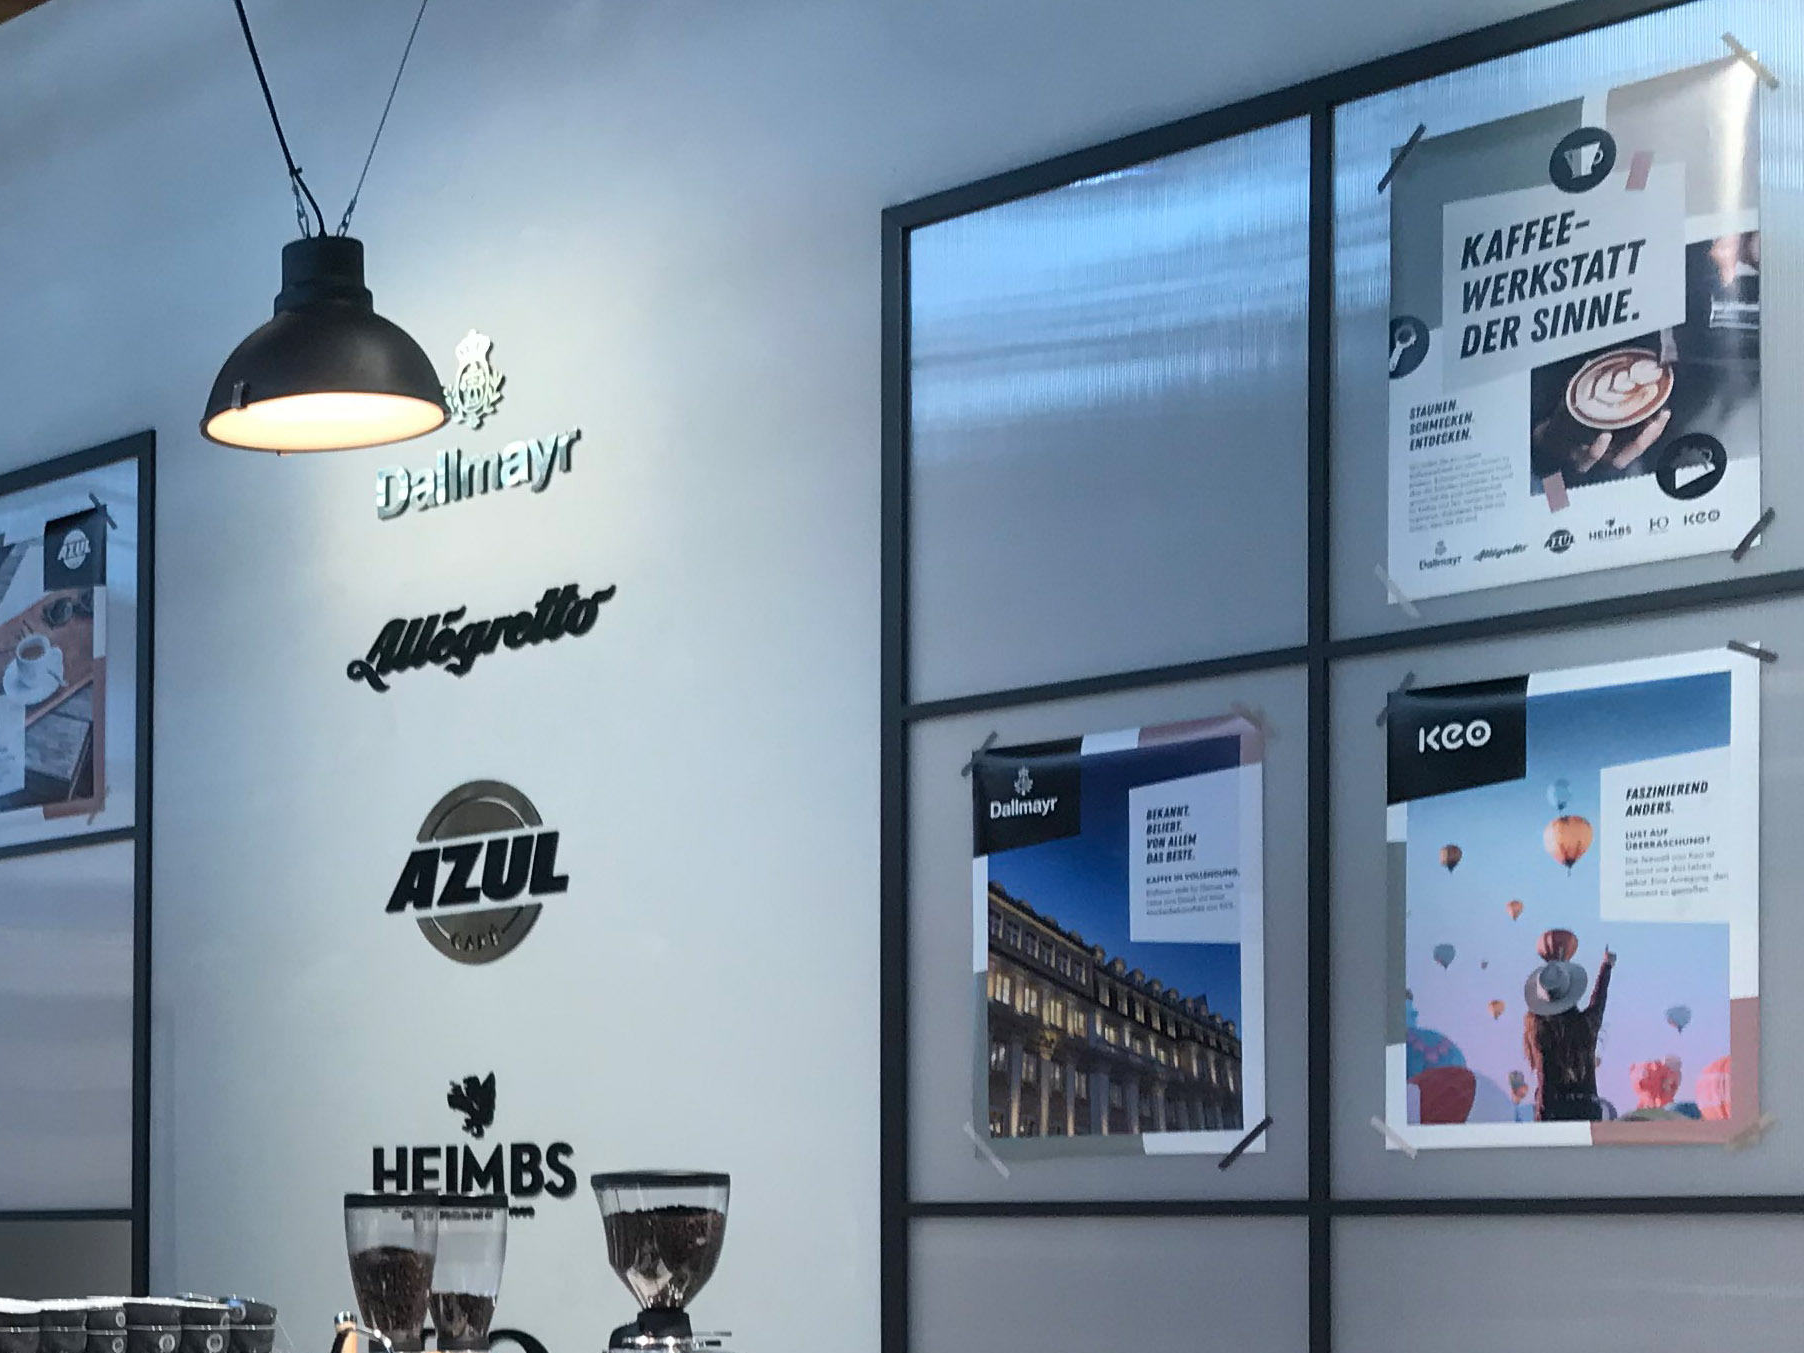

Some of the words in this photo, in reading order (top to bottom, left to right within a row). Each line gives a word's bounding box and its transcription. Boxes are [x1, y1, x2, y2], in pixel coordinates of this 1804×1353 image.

[1461, 210, 1590, 271] KAFFEE-
[1463, 239, 1646, 314] WERKSTATT
[1461, 315, 1521, 359] DER
[1531, 288, 1640, 343] SINNE.
[376, 427, 581, 521] Dallmayr
[1589, 525, 1631, 541] HEIMBS
[1626, 780, 1709, 801] FASZINIEREND
[990, 797, 1058, 820] Dallmayr
[1146, 805, 1191, 821] BEKANNT.
[1625, 801, 1675, 818] ANDERS.
[1146, 837, 1166, 850] VON
[1146, 851, 1164, 865] DAS
[385, 831, 570, 914] AZUL
[372, 1142, 577, 1198] HEIMBS
